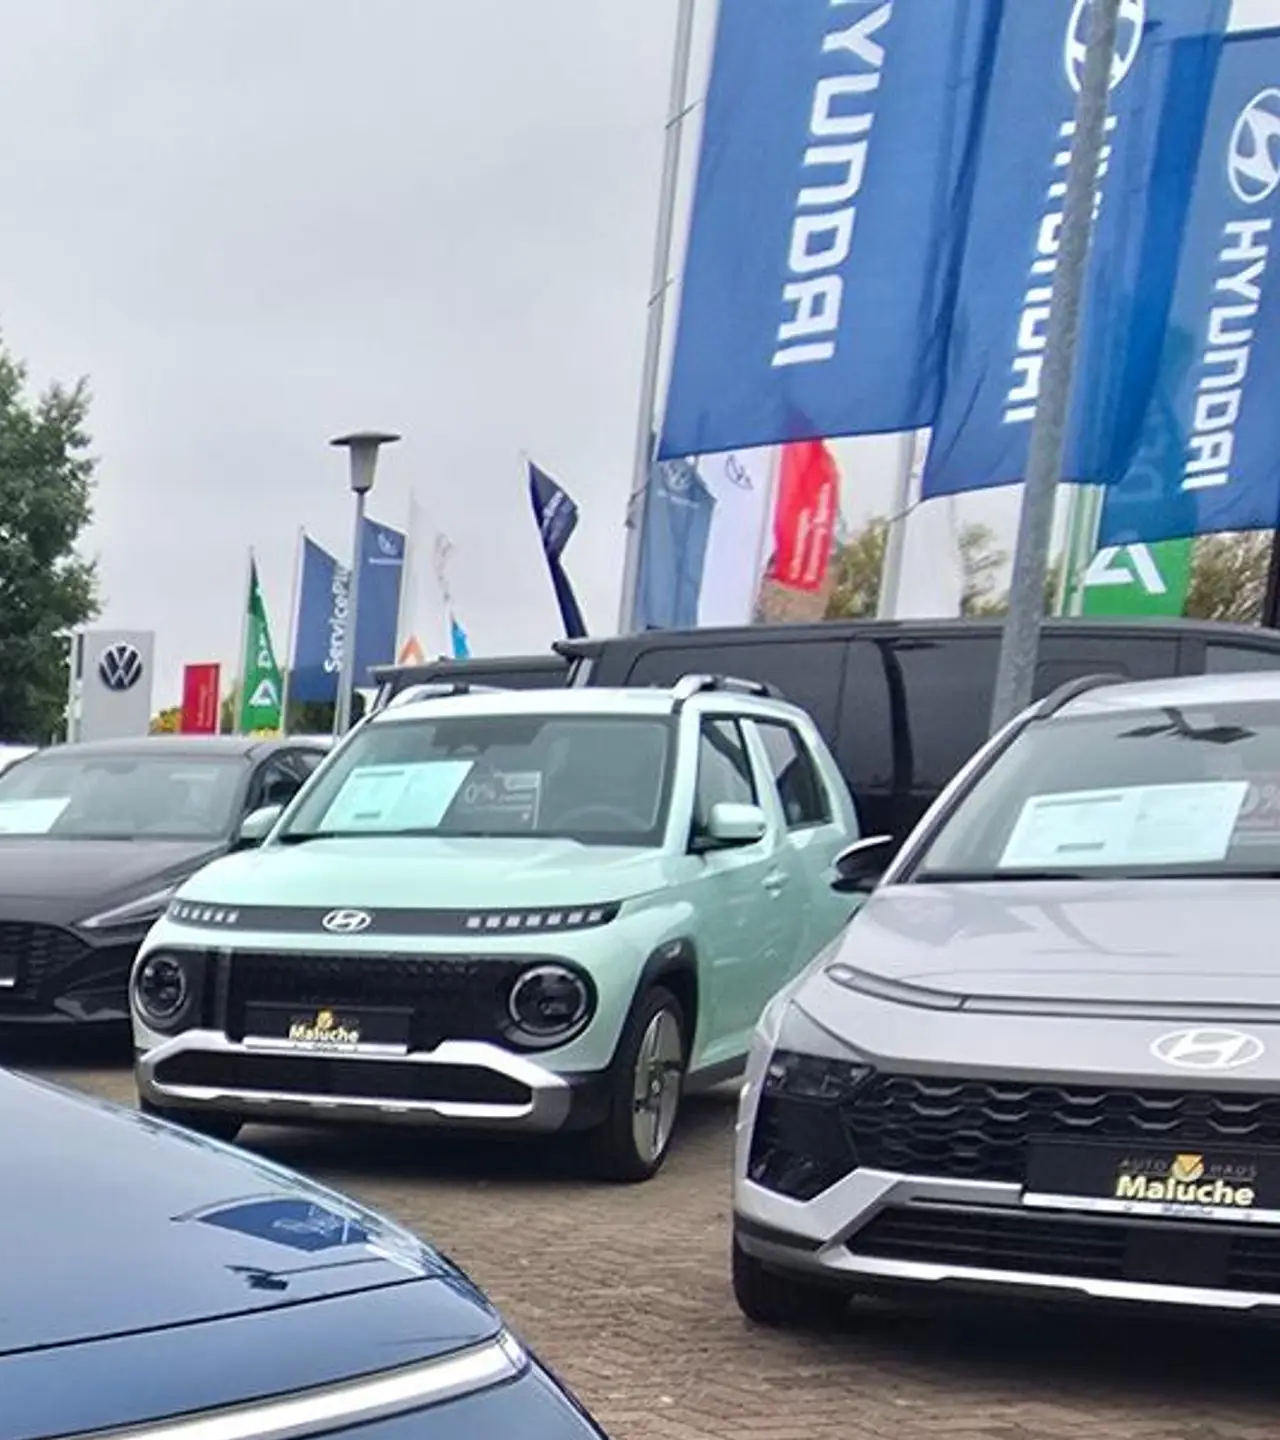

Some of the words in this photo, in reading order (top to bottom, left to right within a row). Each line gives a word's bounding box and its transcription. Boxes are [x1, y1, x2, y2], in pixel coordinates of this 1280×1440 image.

[772, 0, 894, 367] YUNDAI
[1181, 218, 1273, 490] HYUNDAI
[288, 1023, 359, 1042] Maluche
[1115, 1175, 1255, 1206] Maluche
